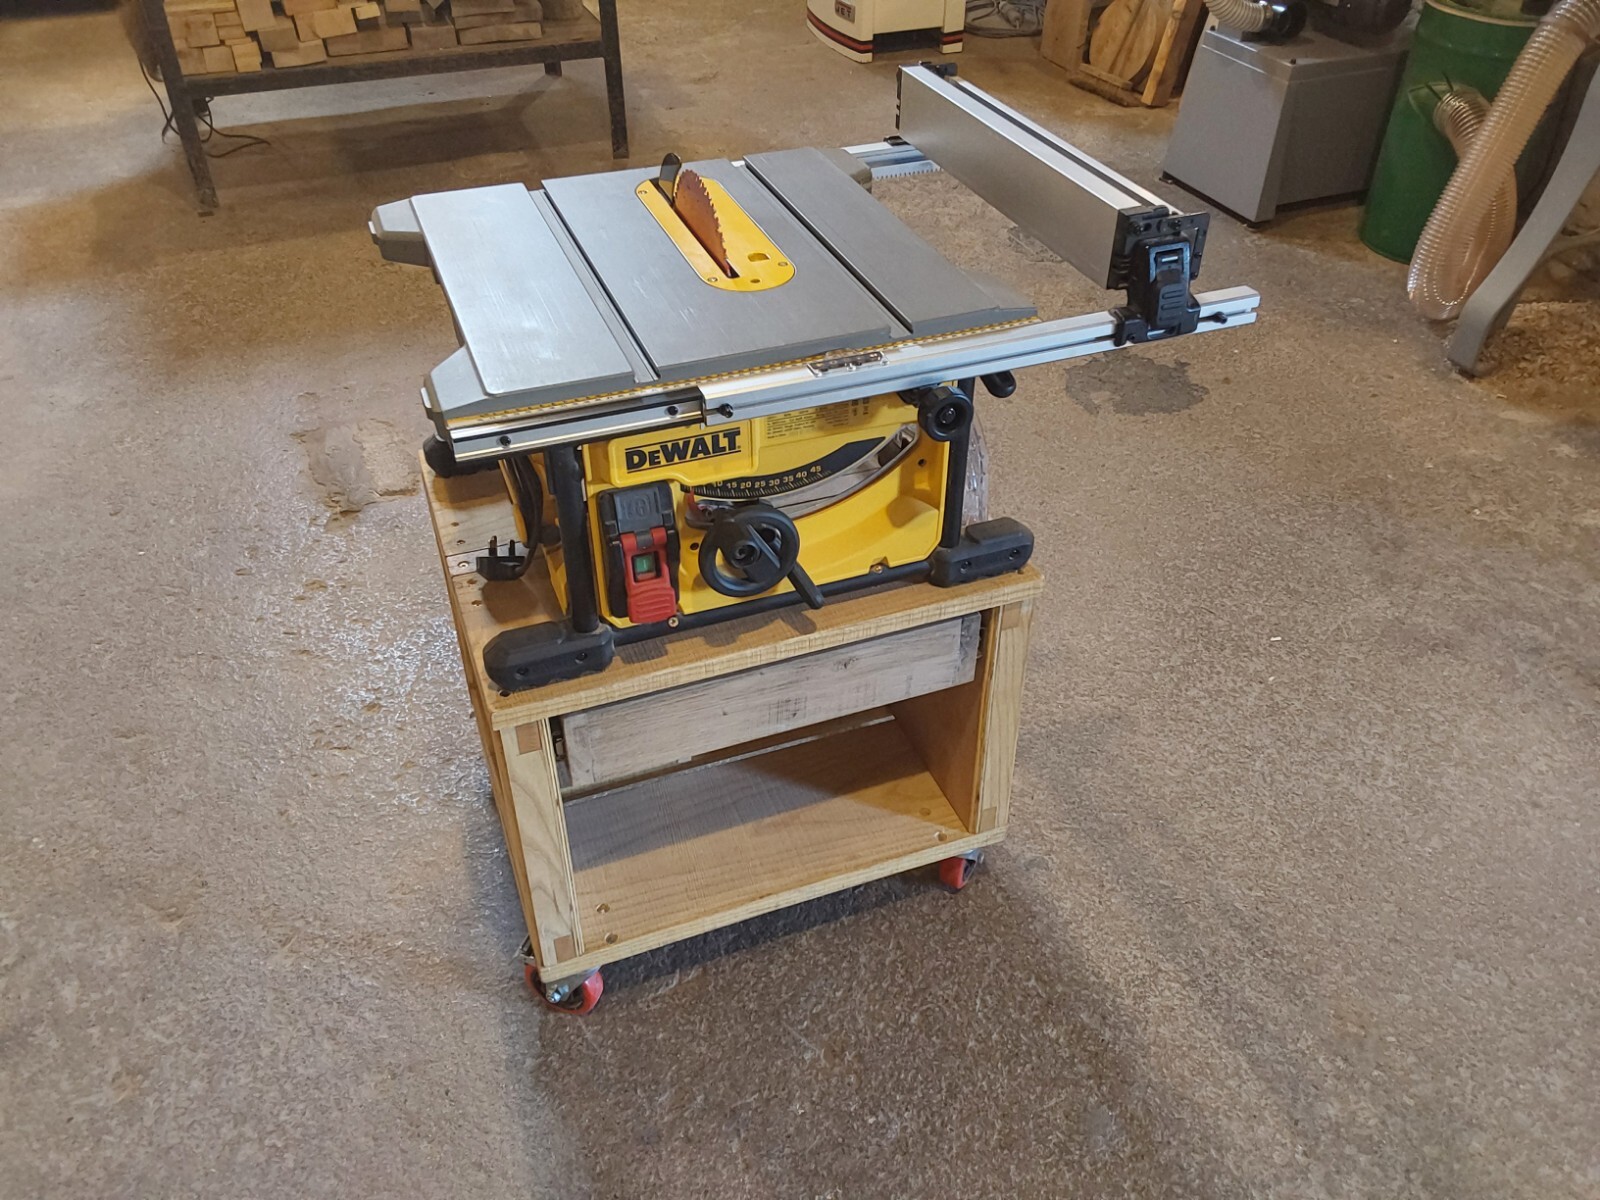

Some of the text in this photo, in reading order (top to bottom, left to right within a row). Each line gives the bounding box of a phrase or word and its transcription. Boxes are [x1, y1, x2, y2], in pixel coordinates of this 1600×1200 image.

[835, 5, 851, 18] JET
[726, 481, 737, 489] 15
[740, 481, 752, 489] 20
[754, 480, 766, 489] 25
[768, 478, 780, 487] 30
[782, 475, 794, 483] 35
[795, 470, 808, 479] 40
[810, 465, 822, 473] 45
